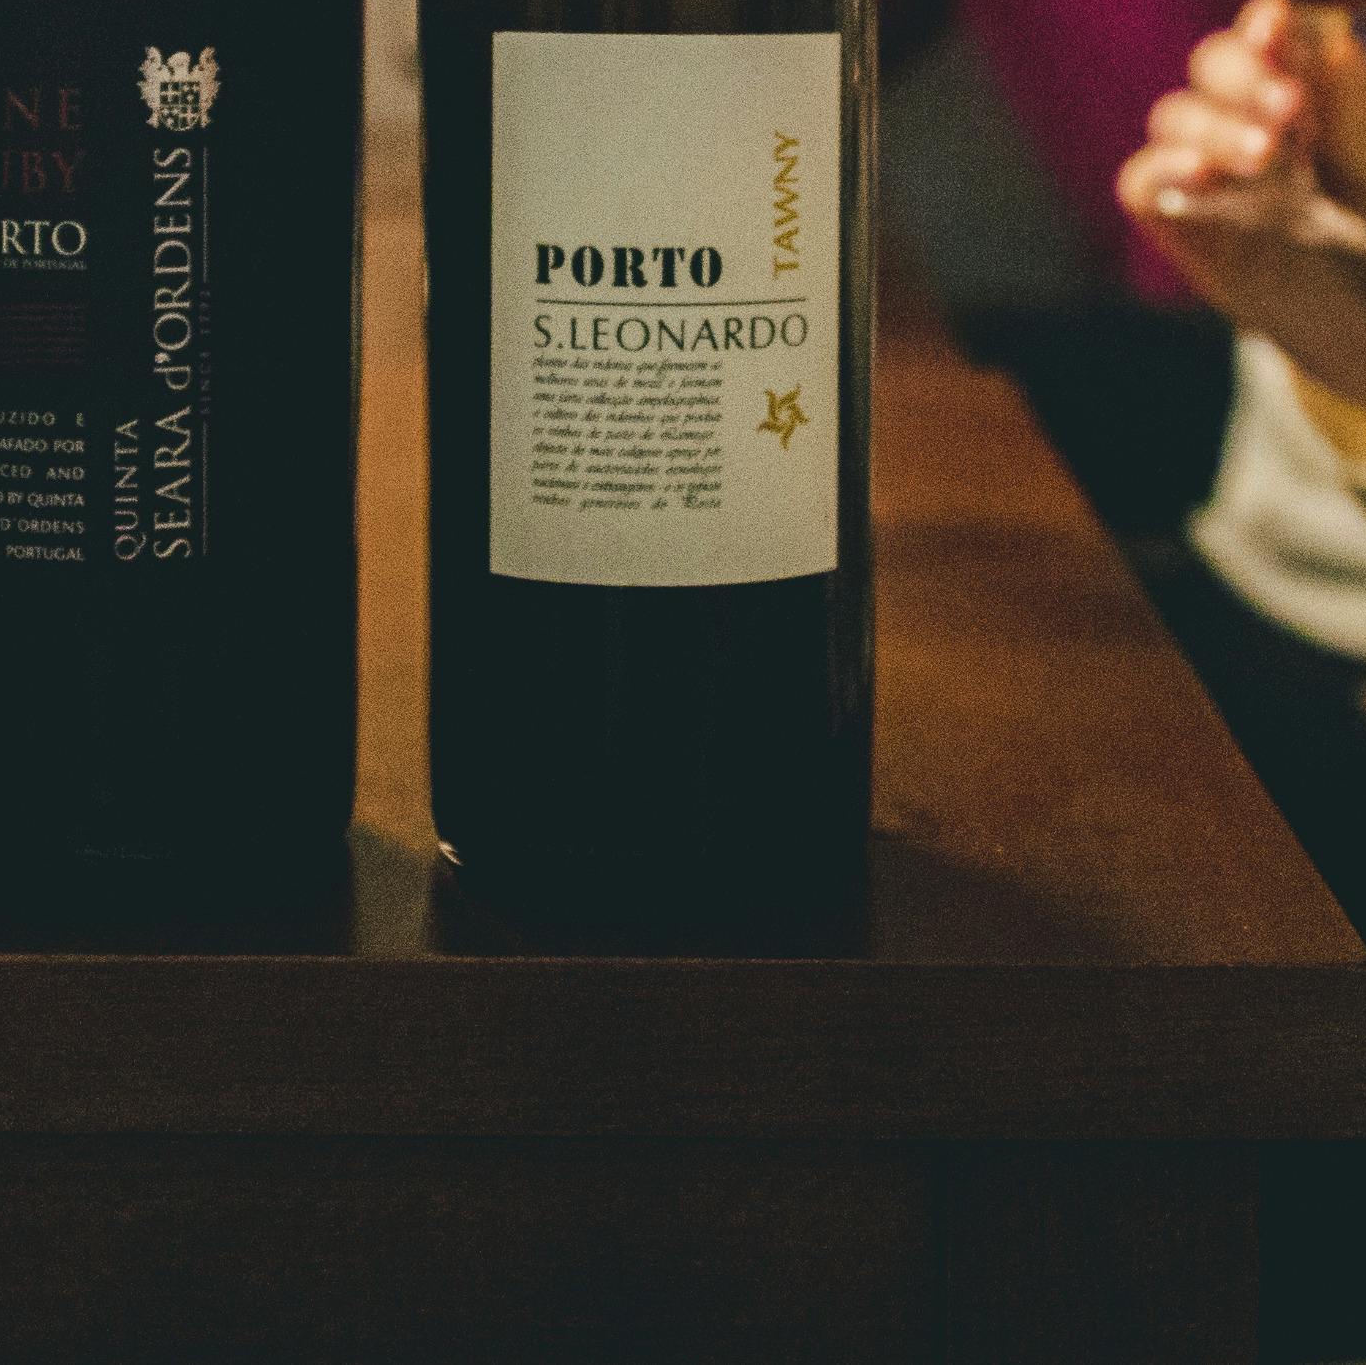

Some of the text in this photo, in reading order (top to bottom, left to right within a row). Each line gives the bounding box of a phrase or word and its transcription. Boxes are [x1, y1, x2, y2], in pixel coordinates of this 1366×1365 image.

[772, 130, 802, 281] TAWNY
[535, 243, 723, 288] PORTO
[534, 313, 809, 352] S.LEONARDO
[154, 146, 192, 559] SEARA d'ORDENS
[53, 439, 84, 453] POR
[46, 466, 85, 481] AND
[115, 418, 147, 561] QUINTA
[27, 492, 85, 508] QUINTA
[6, 544, 85, 561] PORTUGAL
